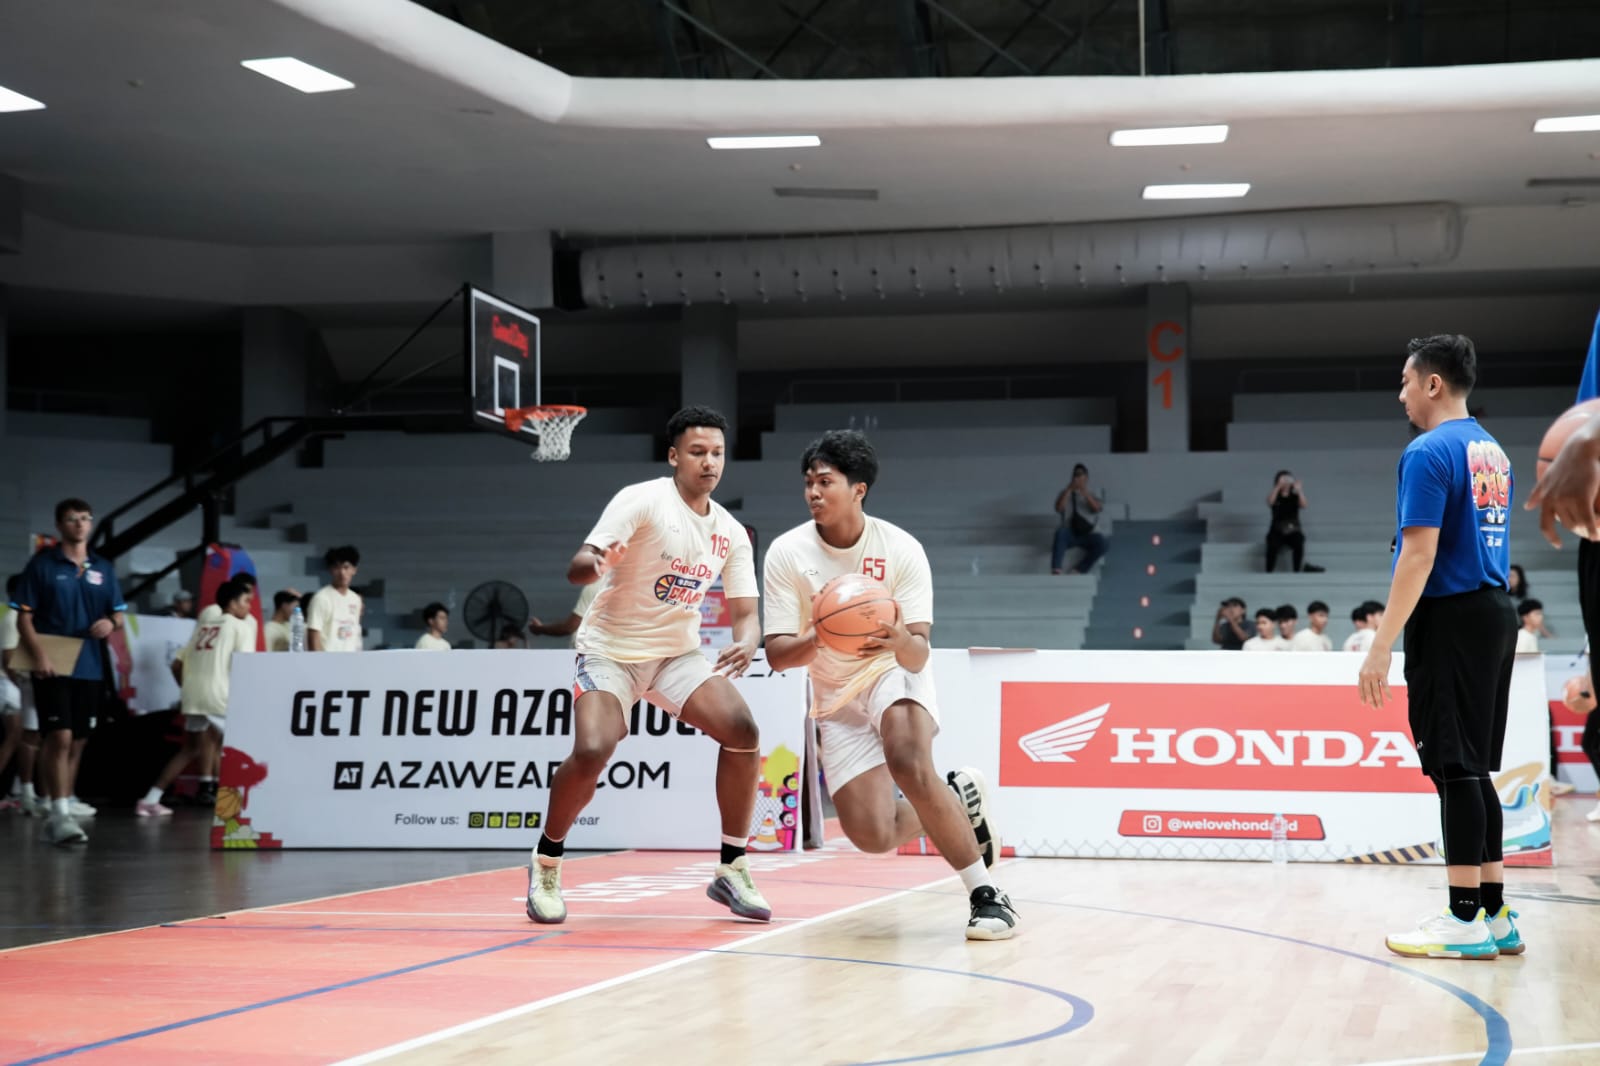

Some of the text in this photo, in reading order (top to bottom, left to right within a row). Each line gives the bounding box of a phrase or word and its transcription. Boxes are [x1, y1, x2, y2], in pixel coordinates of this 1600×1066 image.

[710, 533, 730, 559] 118
[697, 564, 712, 579] Da
[195, 626, 221, 651] 22
[290, 688, 572, 736] GET NEW AZA
[1110, 727, 1423, 768] HONDA
[370, 760, 671, 789] AZAWEAOM
[394, 813, 459, 826] Follow us:
